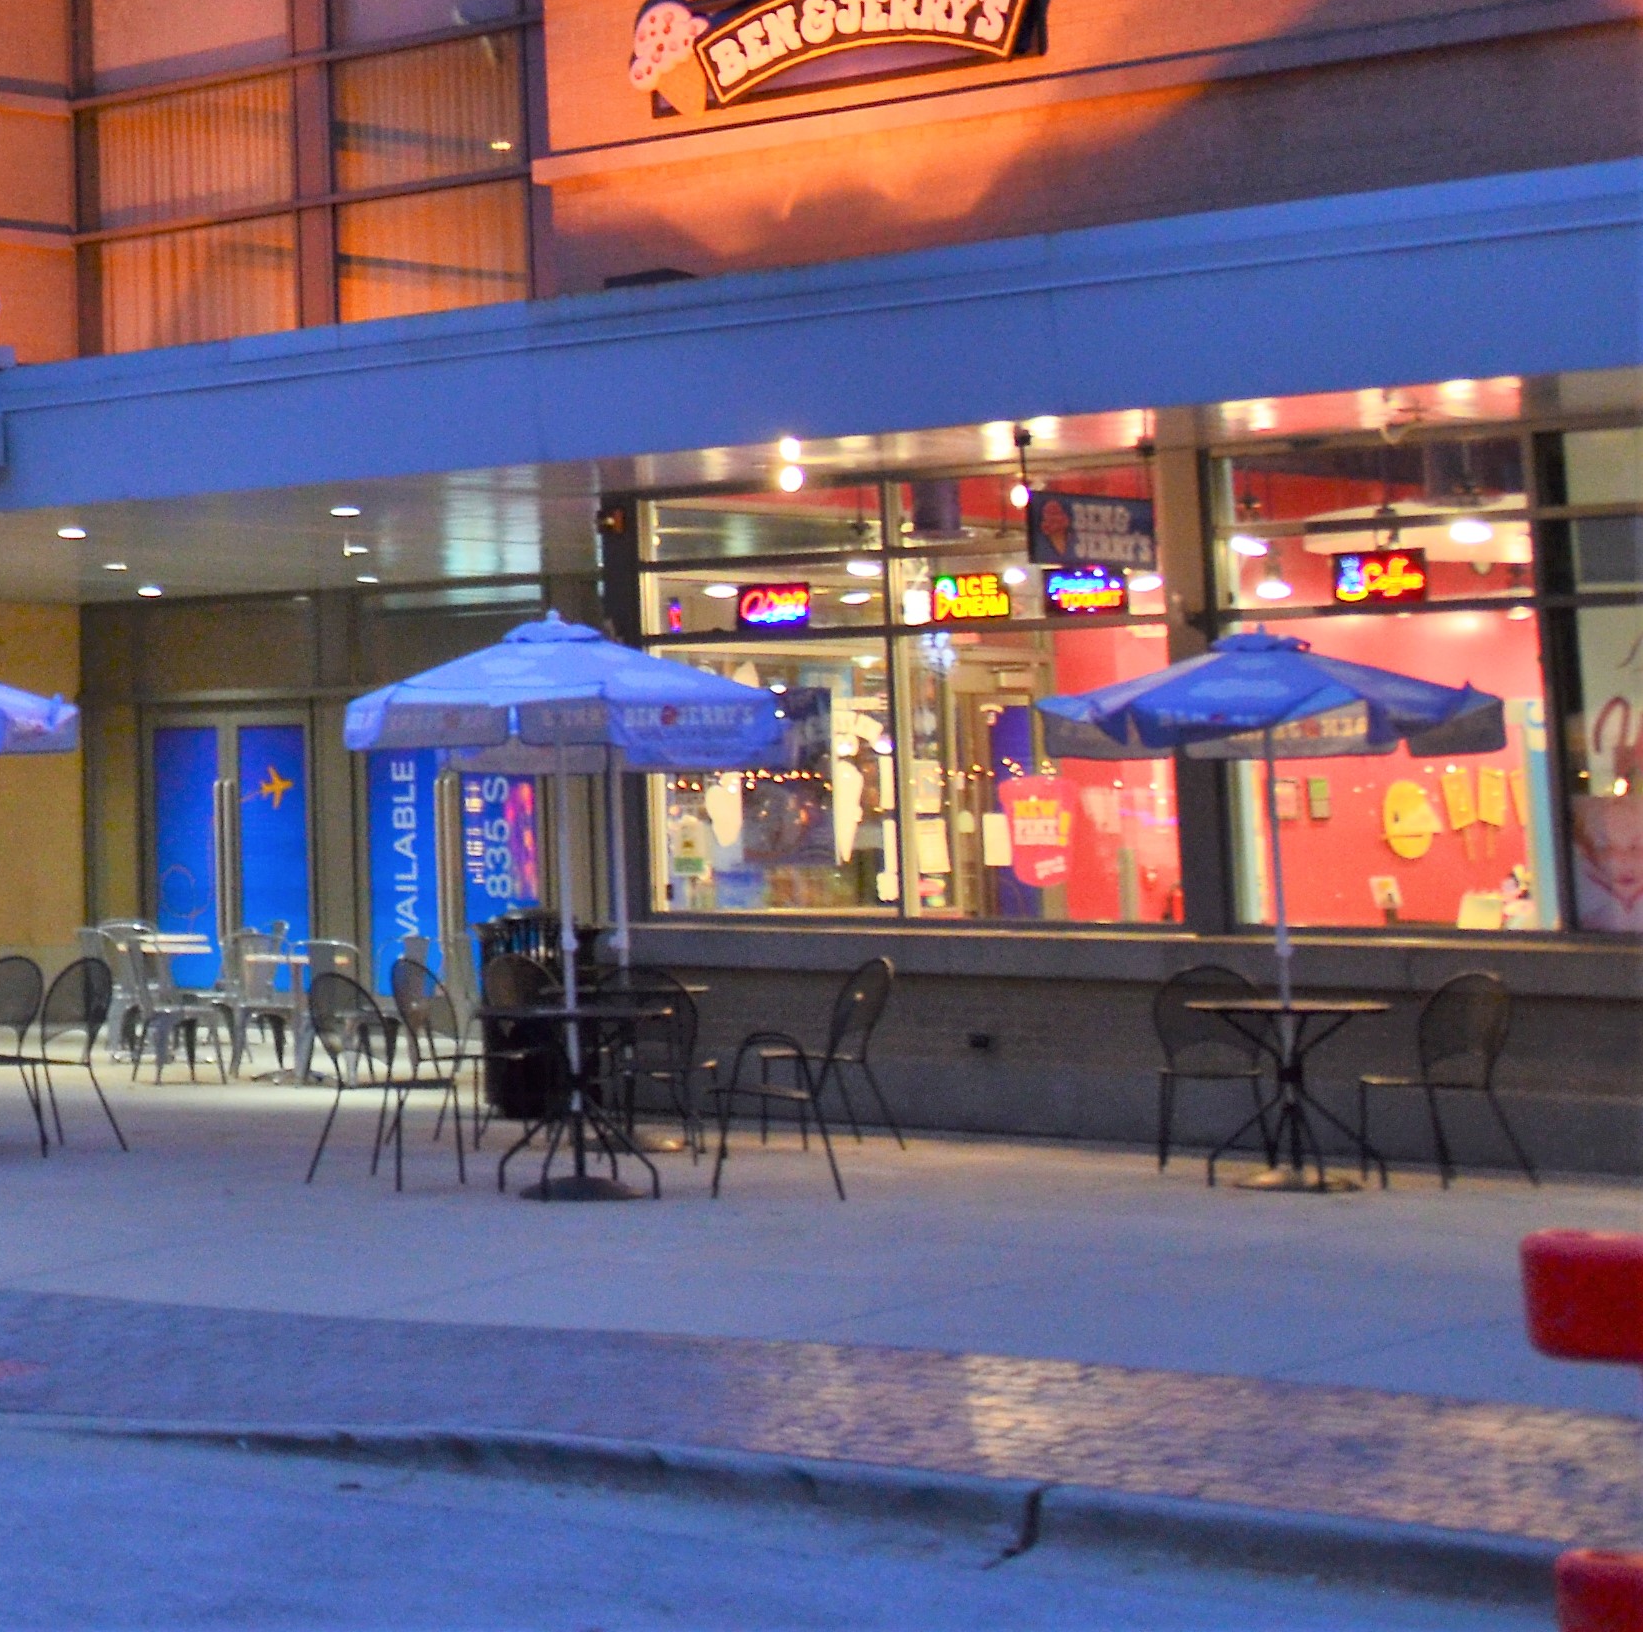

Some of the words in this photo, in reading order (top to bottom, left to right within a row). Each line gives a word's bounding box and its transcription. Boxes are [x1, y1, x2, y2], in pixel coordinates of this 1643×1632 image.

[956, 575, 998, 596] ICE
[950, 593, 1010, 618] CREAM
[390, 760, 420, 944] VAILABLE
